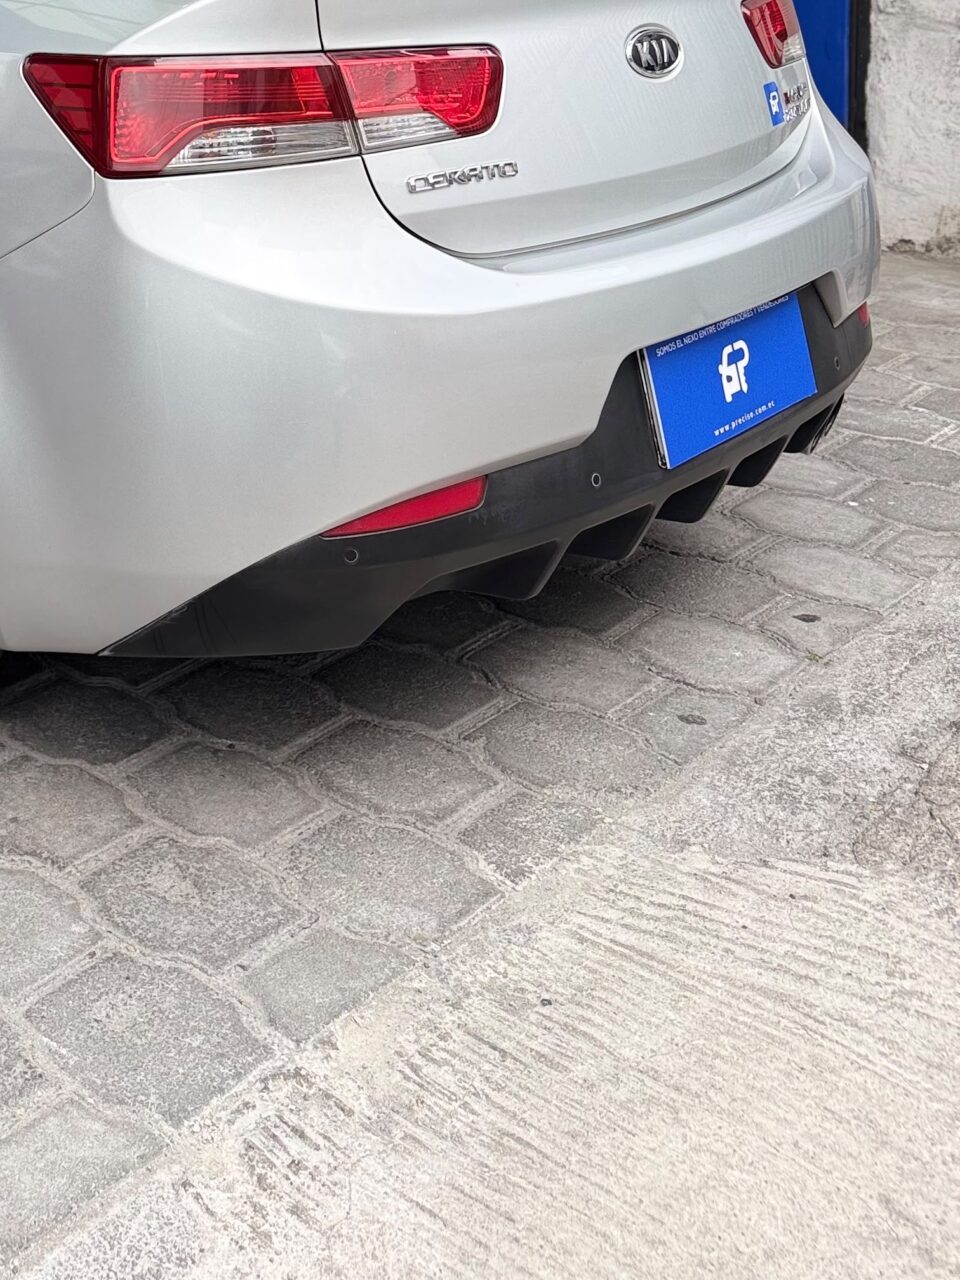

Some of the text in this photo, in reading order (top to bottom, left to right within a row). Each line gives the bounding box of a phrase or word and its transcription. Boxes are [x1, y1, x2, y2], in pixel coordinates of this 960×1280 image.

[634, 36, 678, 71] KIA
[406, 160, 519, 193] CERATO
[655, 341, 677, 357] SOMOS
[676, 338, 684, 349] EL
[683, 332, 699, 344] NEXO
[698, 324, 717, 339] ENTRE
[714, 400, 776, 437] www.preciso.com.ec
